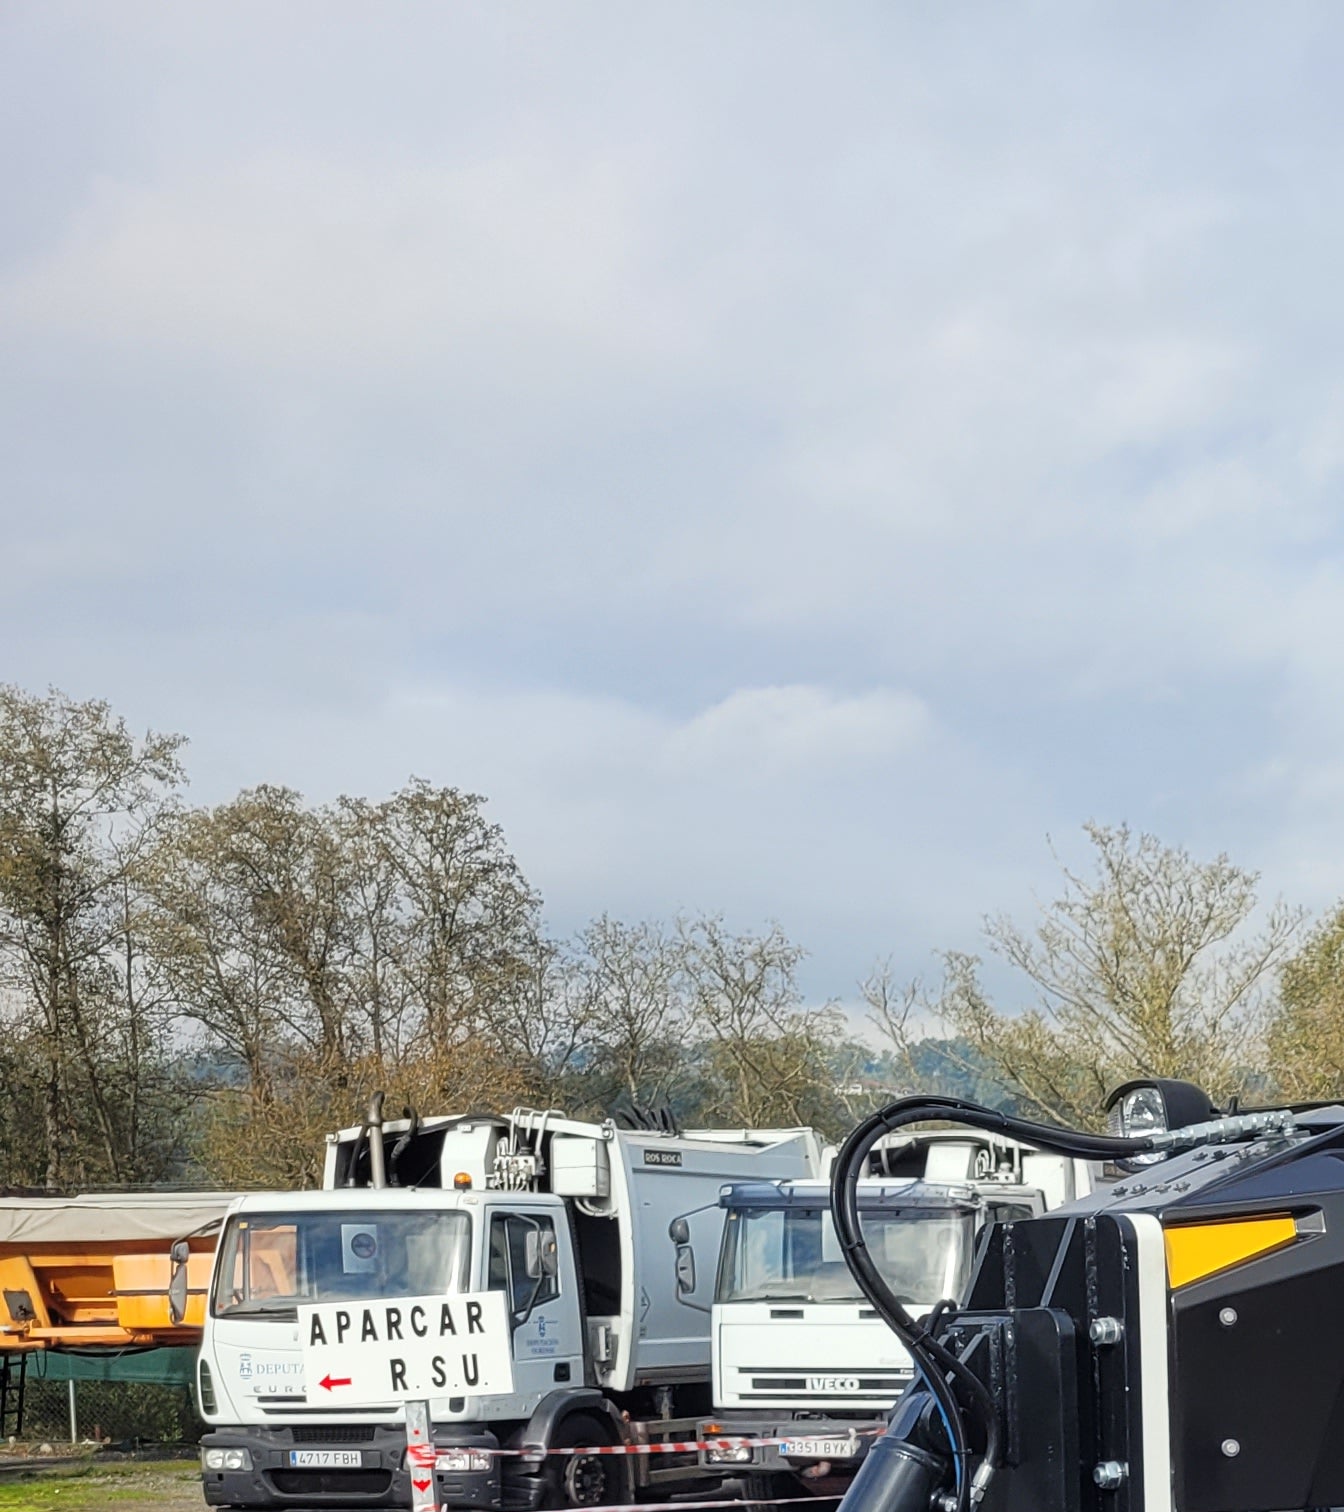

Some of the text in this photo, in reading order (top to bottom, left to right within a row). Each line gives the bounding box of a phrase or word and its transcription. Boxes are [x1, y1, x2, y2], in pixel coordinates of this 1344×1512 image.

[309, 1300, 486, 1347] APARCAR
[804, 1378, 860, 1391] IVECO
[299, 1452, 359, 1465] 4717 FBH
